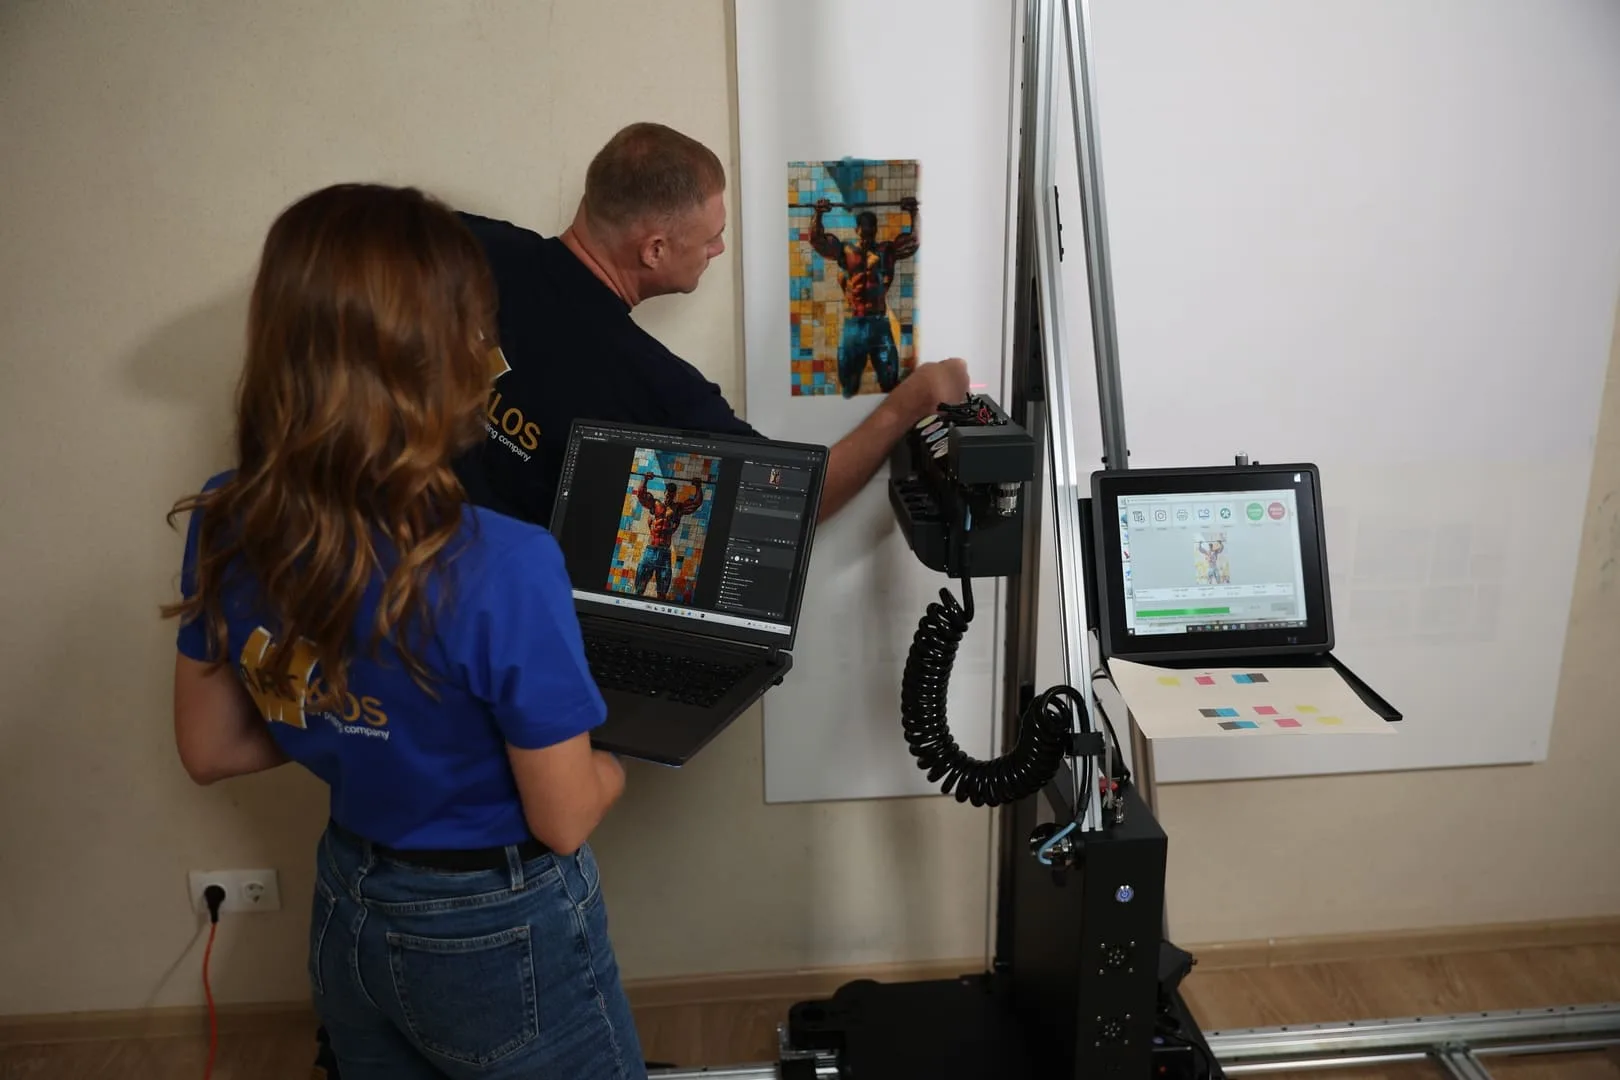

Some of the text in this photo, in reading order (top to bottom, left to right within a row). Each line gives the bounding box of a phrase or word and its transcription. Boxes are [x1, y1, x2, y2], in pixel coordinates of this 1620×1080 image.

[488, 392, 542, 450] LOS
[498, 434, 532, 462] company
[343, 725, 390, 741] company
